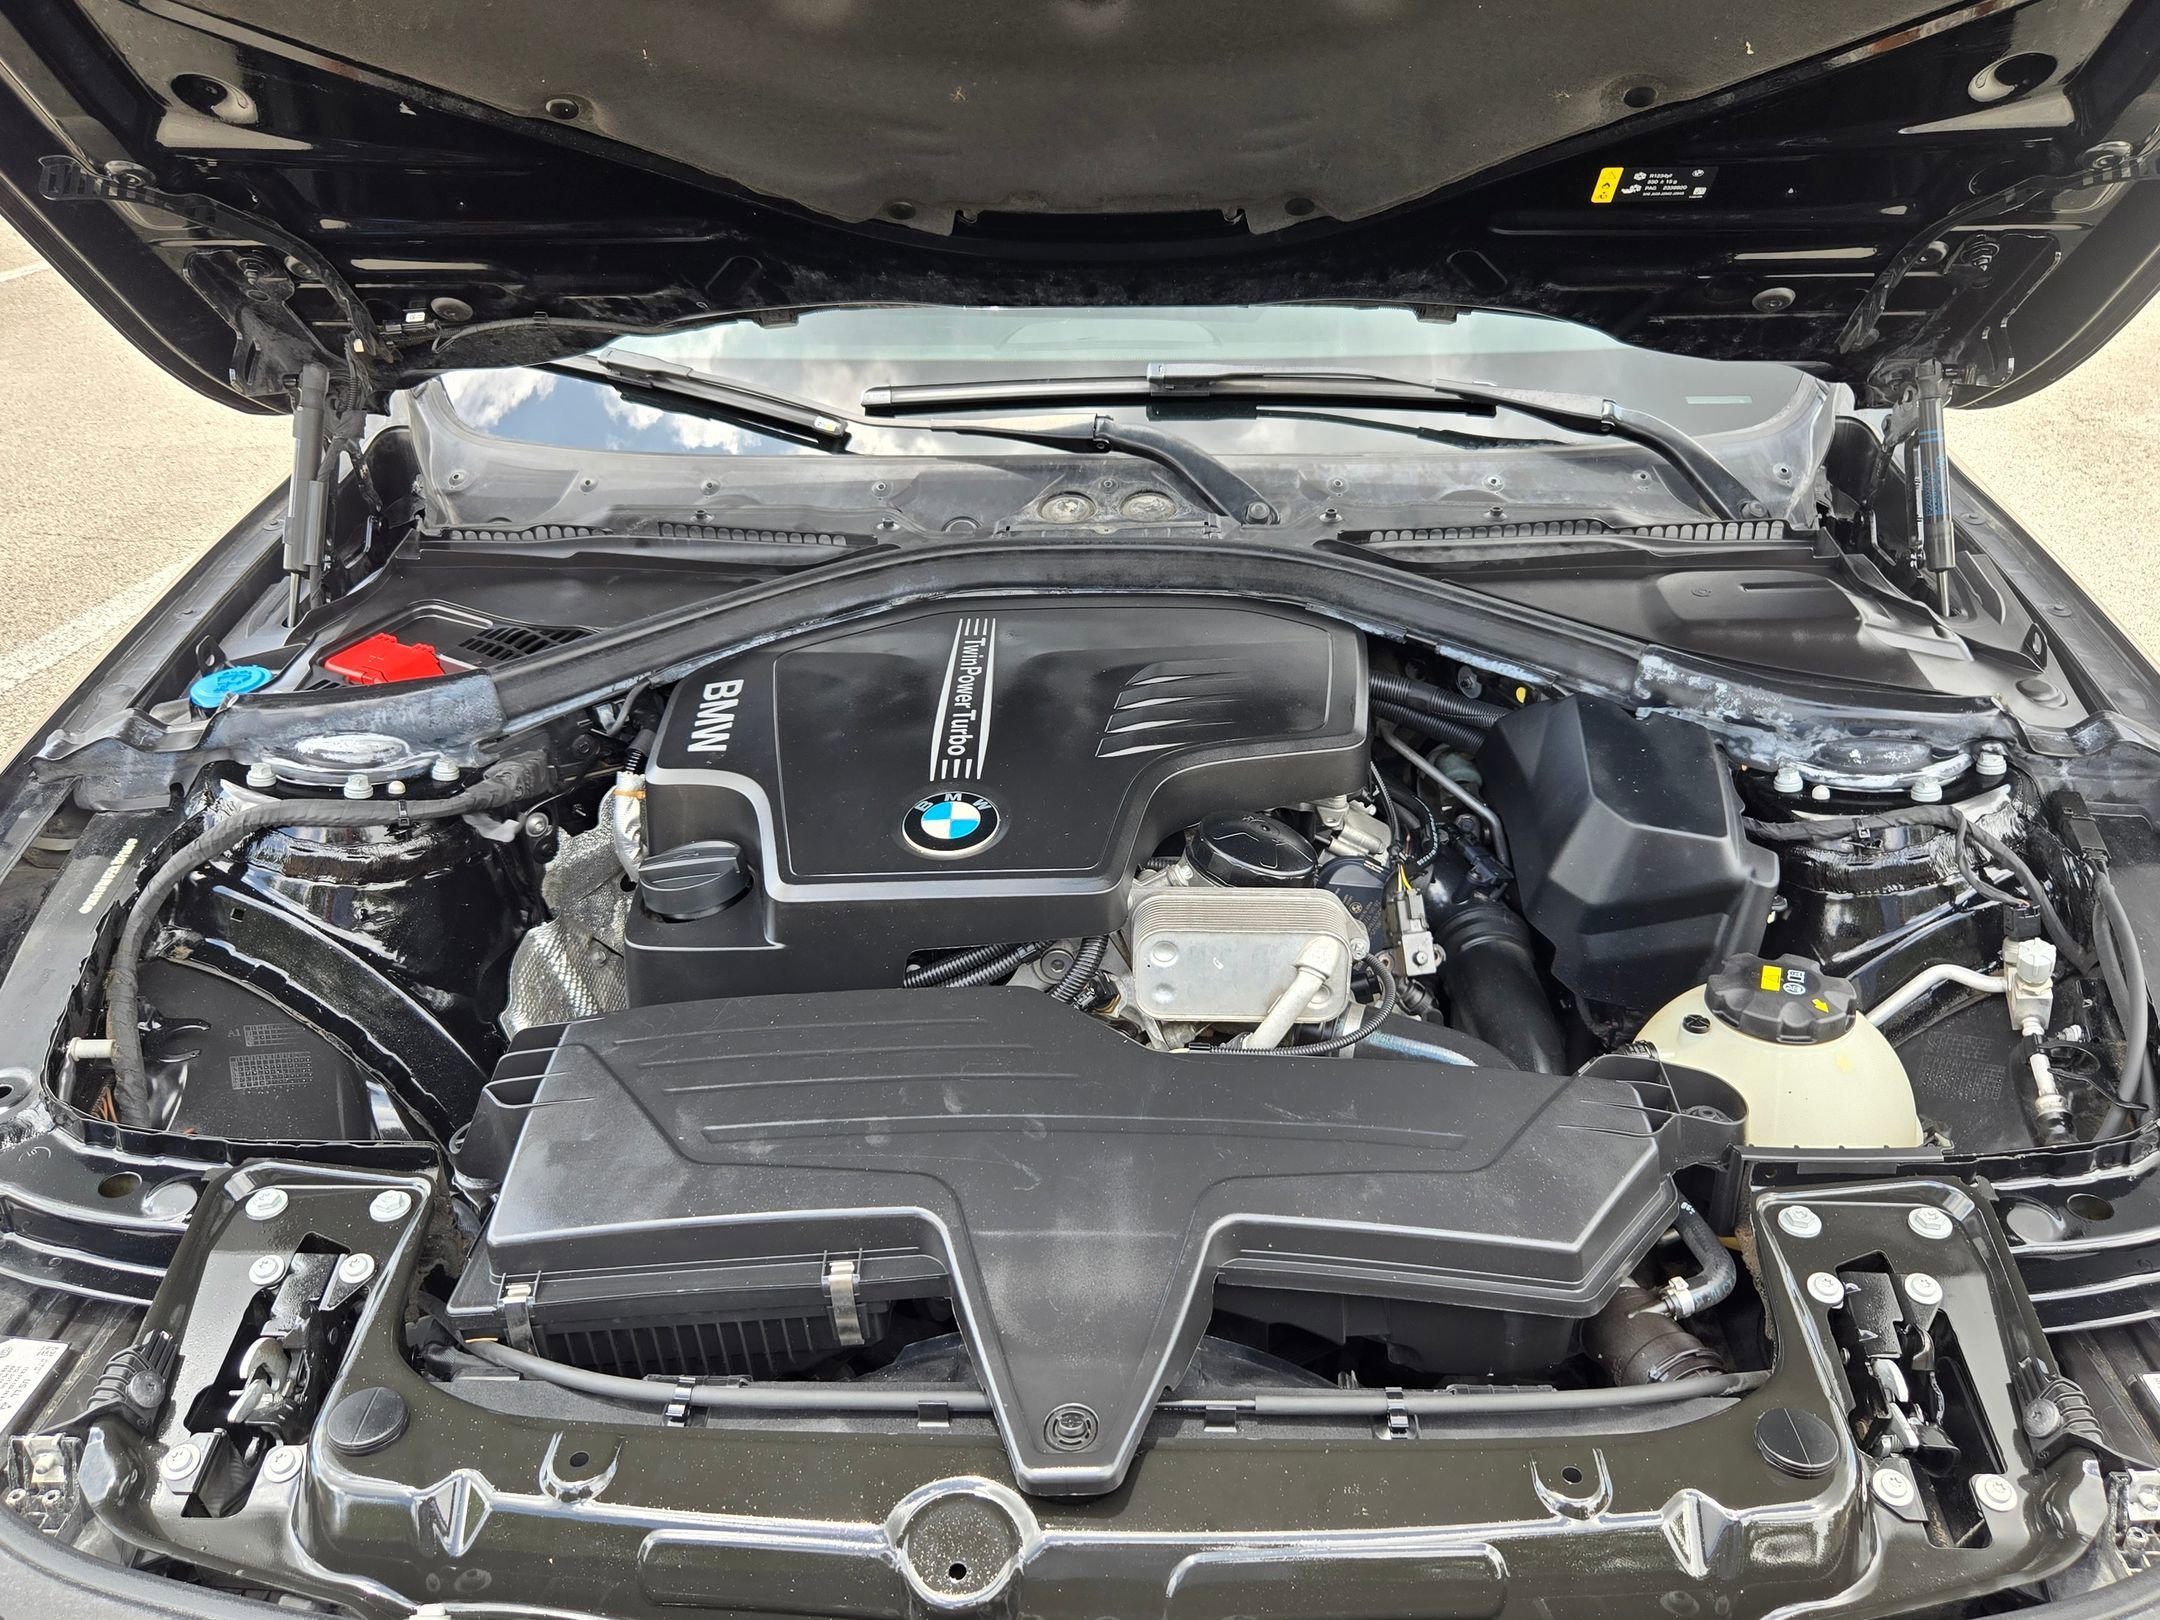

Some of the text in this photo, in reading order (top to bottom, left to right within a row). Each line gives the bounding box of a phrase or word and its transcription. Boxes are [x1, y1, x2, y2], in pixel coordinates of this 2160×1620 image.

[687, 679, 744, 752] BMW
[947, 637, 986, 756] TwinPower Turbo
[915, 793, 992, 812] BMW
